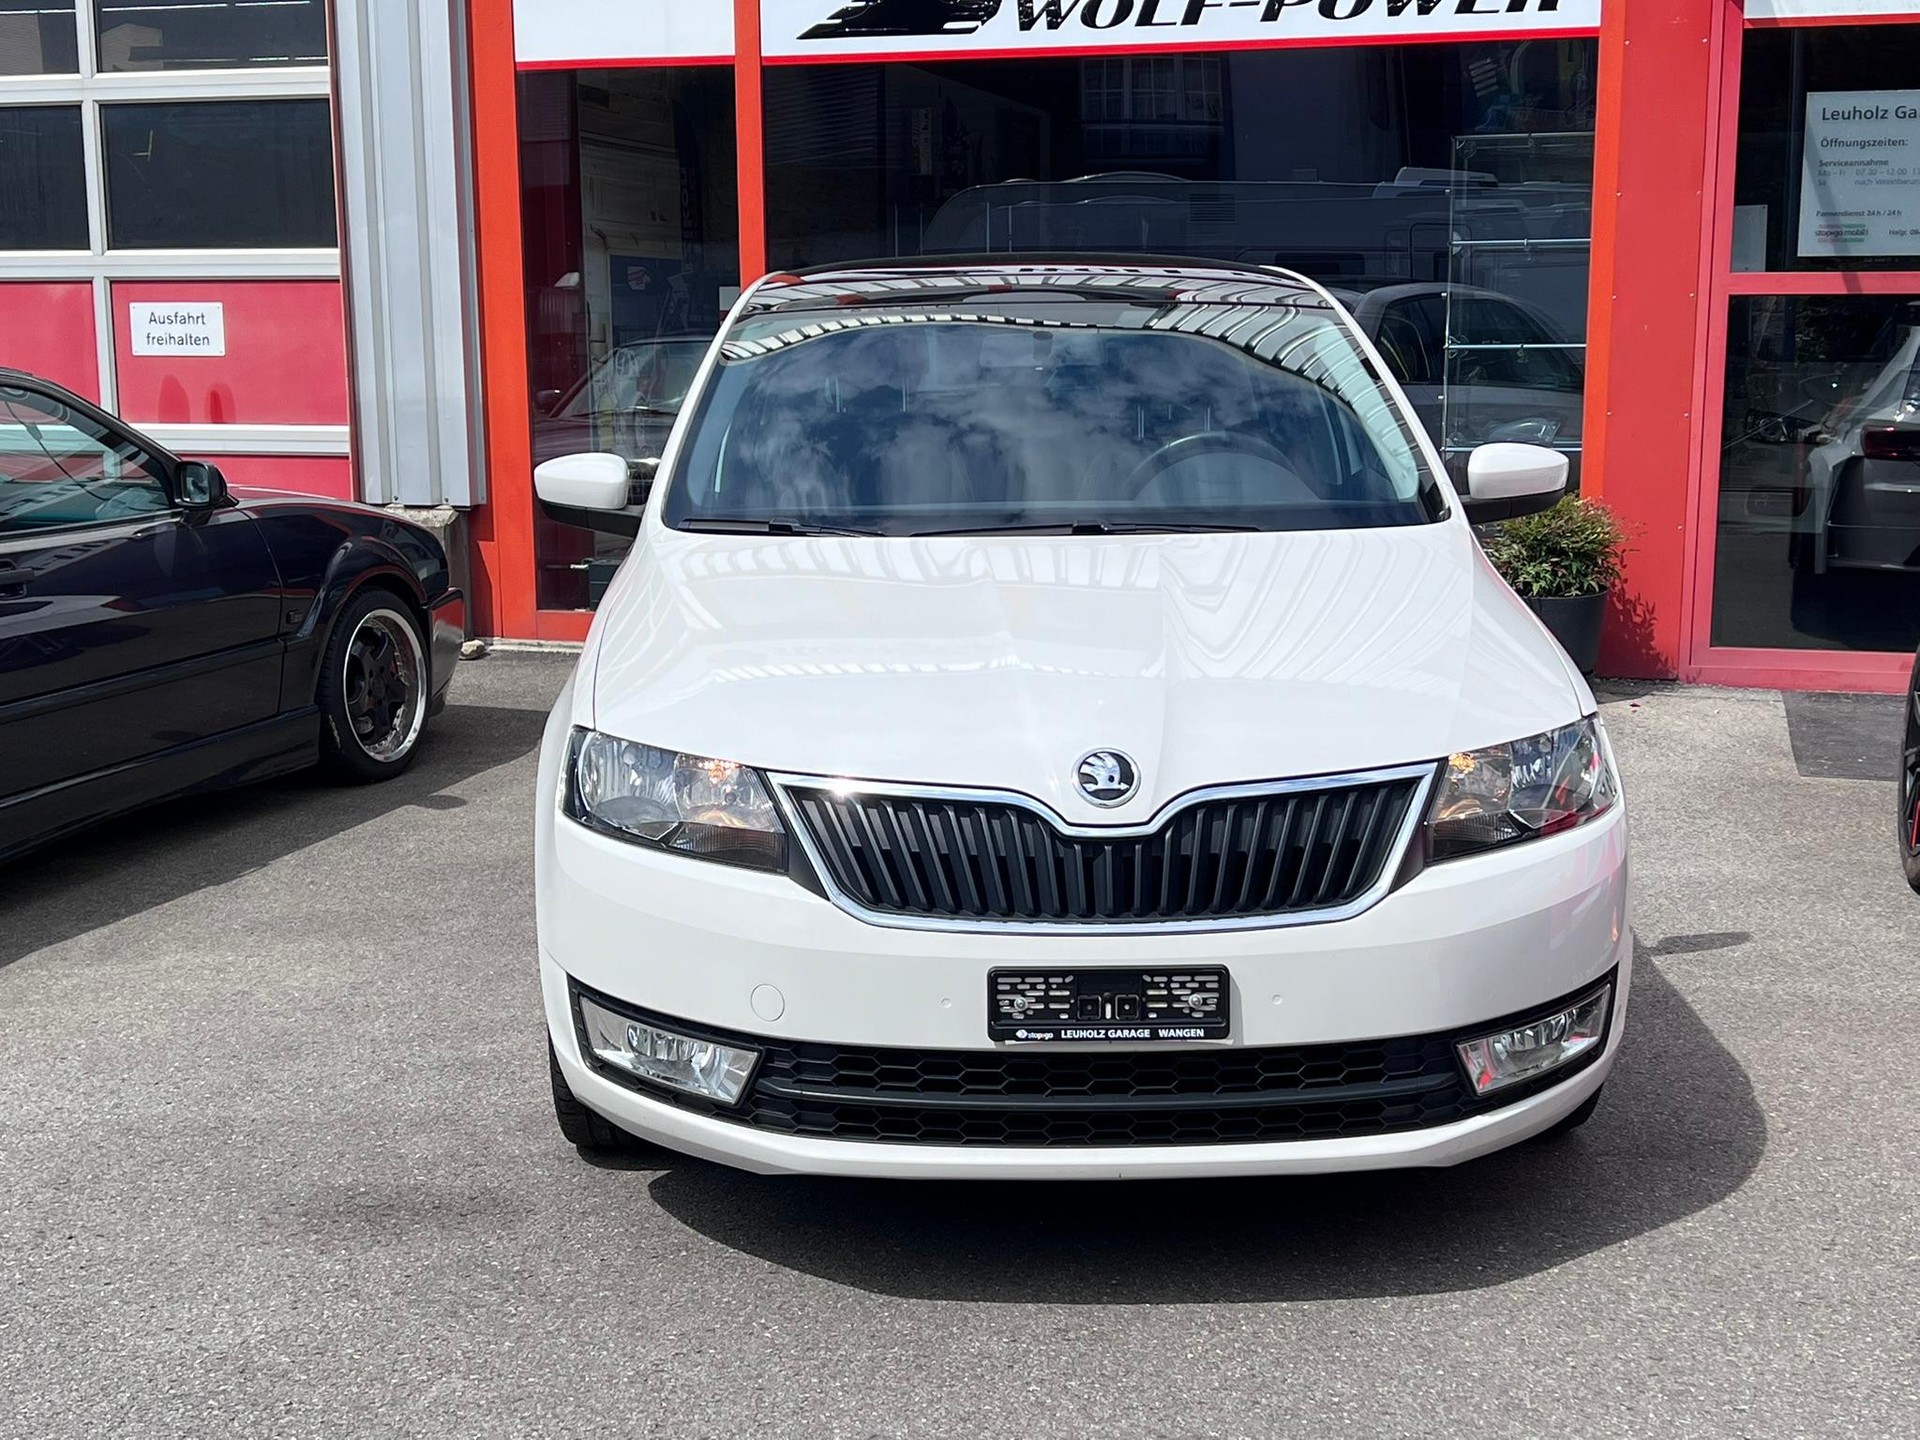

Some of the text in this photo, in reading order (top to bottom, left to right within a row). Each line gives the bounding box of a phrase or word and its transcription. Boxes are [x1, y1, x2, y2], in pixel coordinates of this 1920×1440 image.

[1018, 0, 1558, 32] WOLF-PO
[1821, 105, 1920, 121] Leuholz Ga
[1820, 136, 1909, 150] Öffnungszeiten:
[1818, 159, 1889, 167] Serviceannahme
[148, 311, 206, 325] Ausfahrt
[146, 332, 210, 346] freihalten
[1061, 1029, 1106, 1039] LEUHOLZ
[1108, 1029, 1151, 1039] GARAGE
[1158, 1028, 1205, 1038] WANGEN
